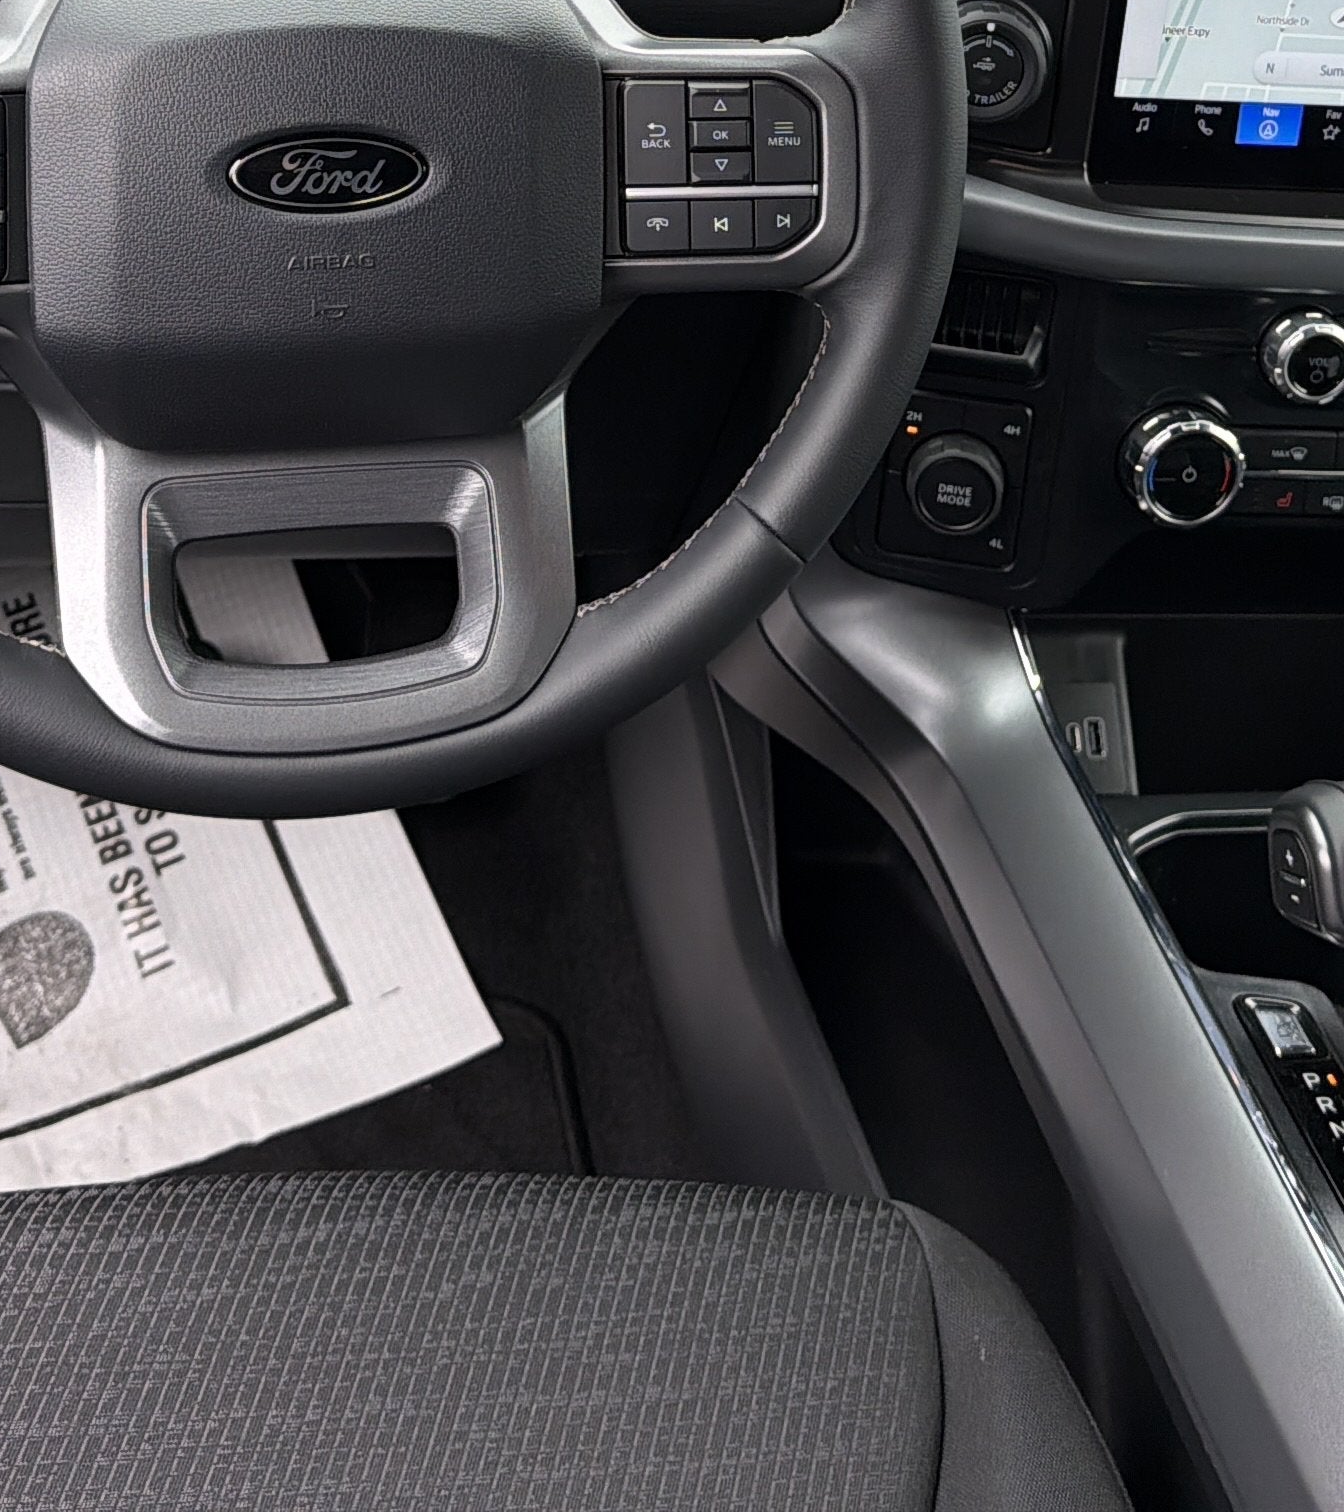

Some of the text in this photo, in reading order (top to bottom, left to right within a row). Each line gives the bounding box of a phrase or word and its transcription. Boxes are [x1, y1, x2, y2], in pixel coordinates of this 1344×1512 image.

[1256, 15, 1299, 26] Northside
[1265, 63, 1275, 74] N
[974, 80, 1018, 105] TRAILER
[1132, 102, 1157, 113] Audio
[1194, 104, 1222, 116] Phone
[1262, 106, 1280, 118] Nav
[1325, 109, 1343, 120] Fav
[712, 130, 729, 141] OK
[767, 136, 801, 147] MENU
[641, 138, 671, 149] BACK
[270, 148, 387, 196] Ford
[287, 252, 377, 272] AIRBAG
[906, 411, 923, 422] 2H
[1003, 425, 1022, 436] 4H
[938, 483, 973, 496] DRIVE
[936, 494, 972, 507] MODE
[989, 538, 1004, 550] 4L
[2, 806, 28, 855] always
[144, 828, 187, 876] TO
[19, 855, 37, 881] are
[108, 864, 163, 941] HAS
[134, 941, 176, 980] IT
[1301, 1072, 1321, 1091] P
[1315, 1096, 1338, 1115] R
